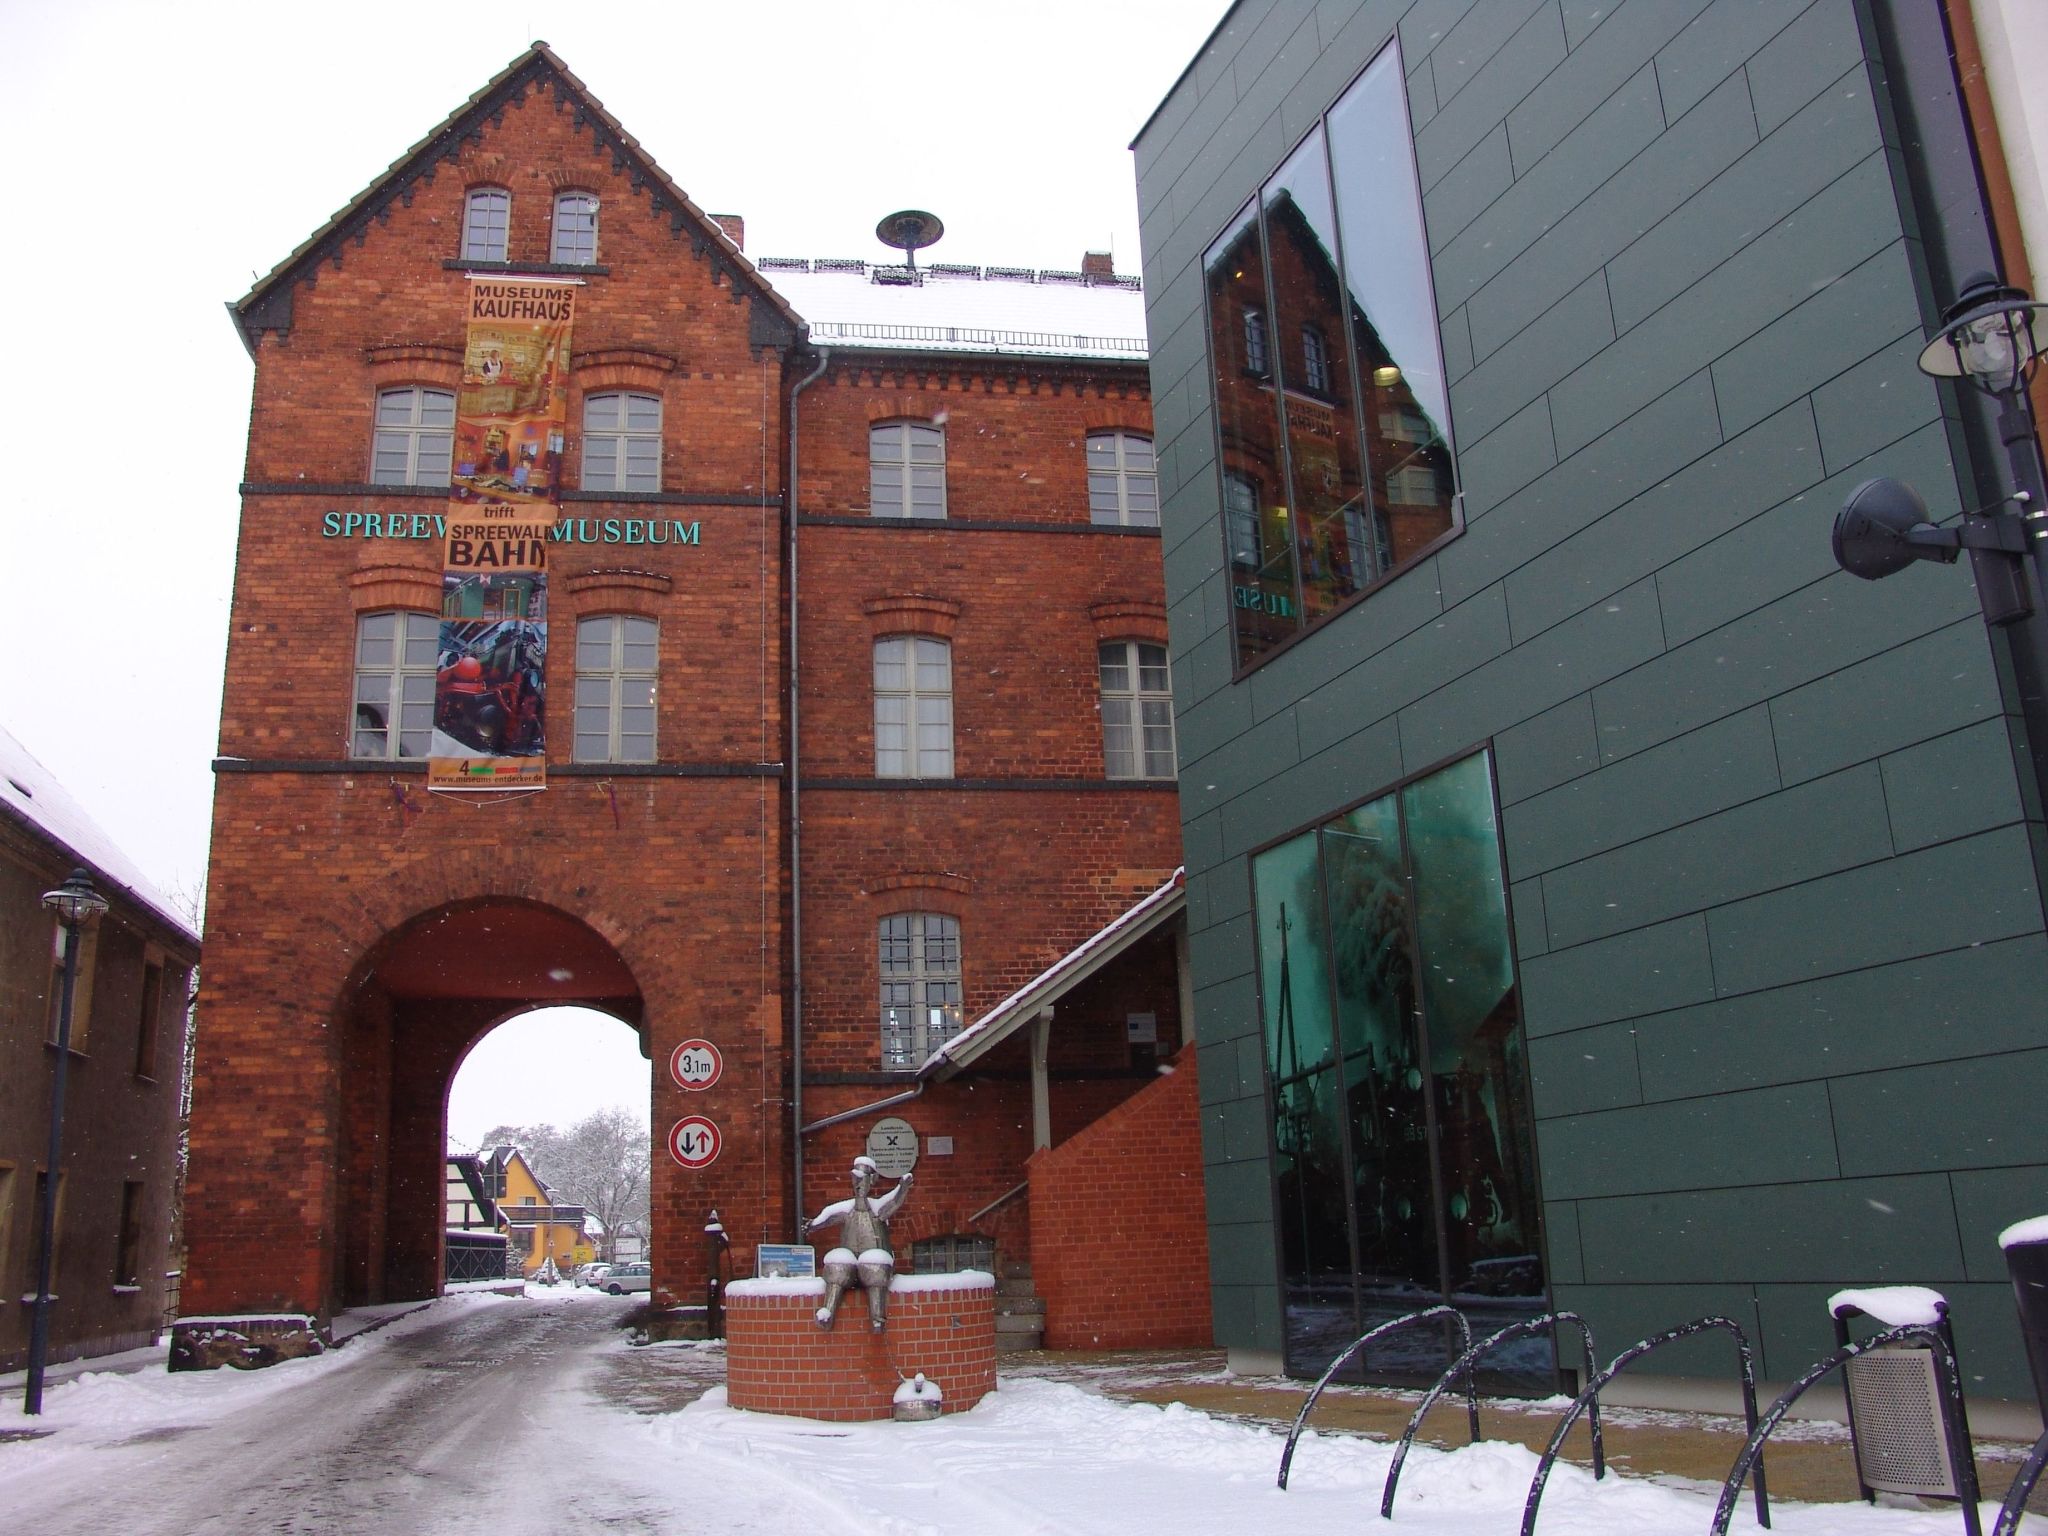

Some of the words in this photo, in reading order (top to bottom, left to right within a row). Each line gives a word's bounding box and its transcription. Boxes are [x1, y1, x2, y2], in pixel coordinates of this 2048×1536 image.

[474, 285, 574, 302] MUSEUMS
[472, 299, 572, 321] KAUFHAUS
[483, 506, 516, 519] trifft
[549, 517, 702, 546] MUSEUM
[449, 540, 546, 568] BAHN
[459, 760, 470, 776] 4
